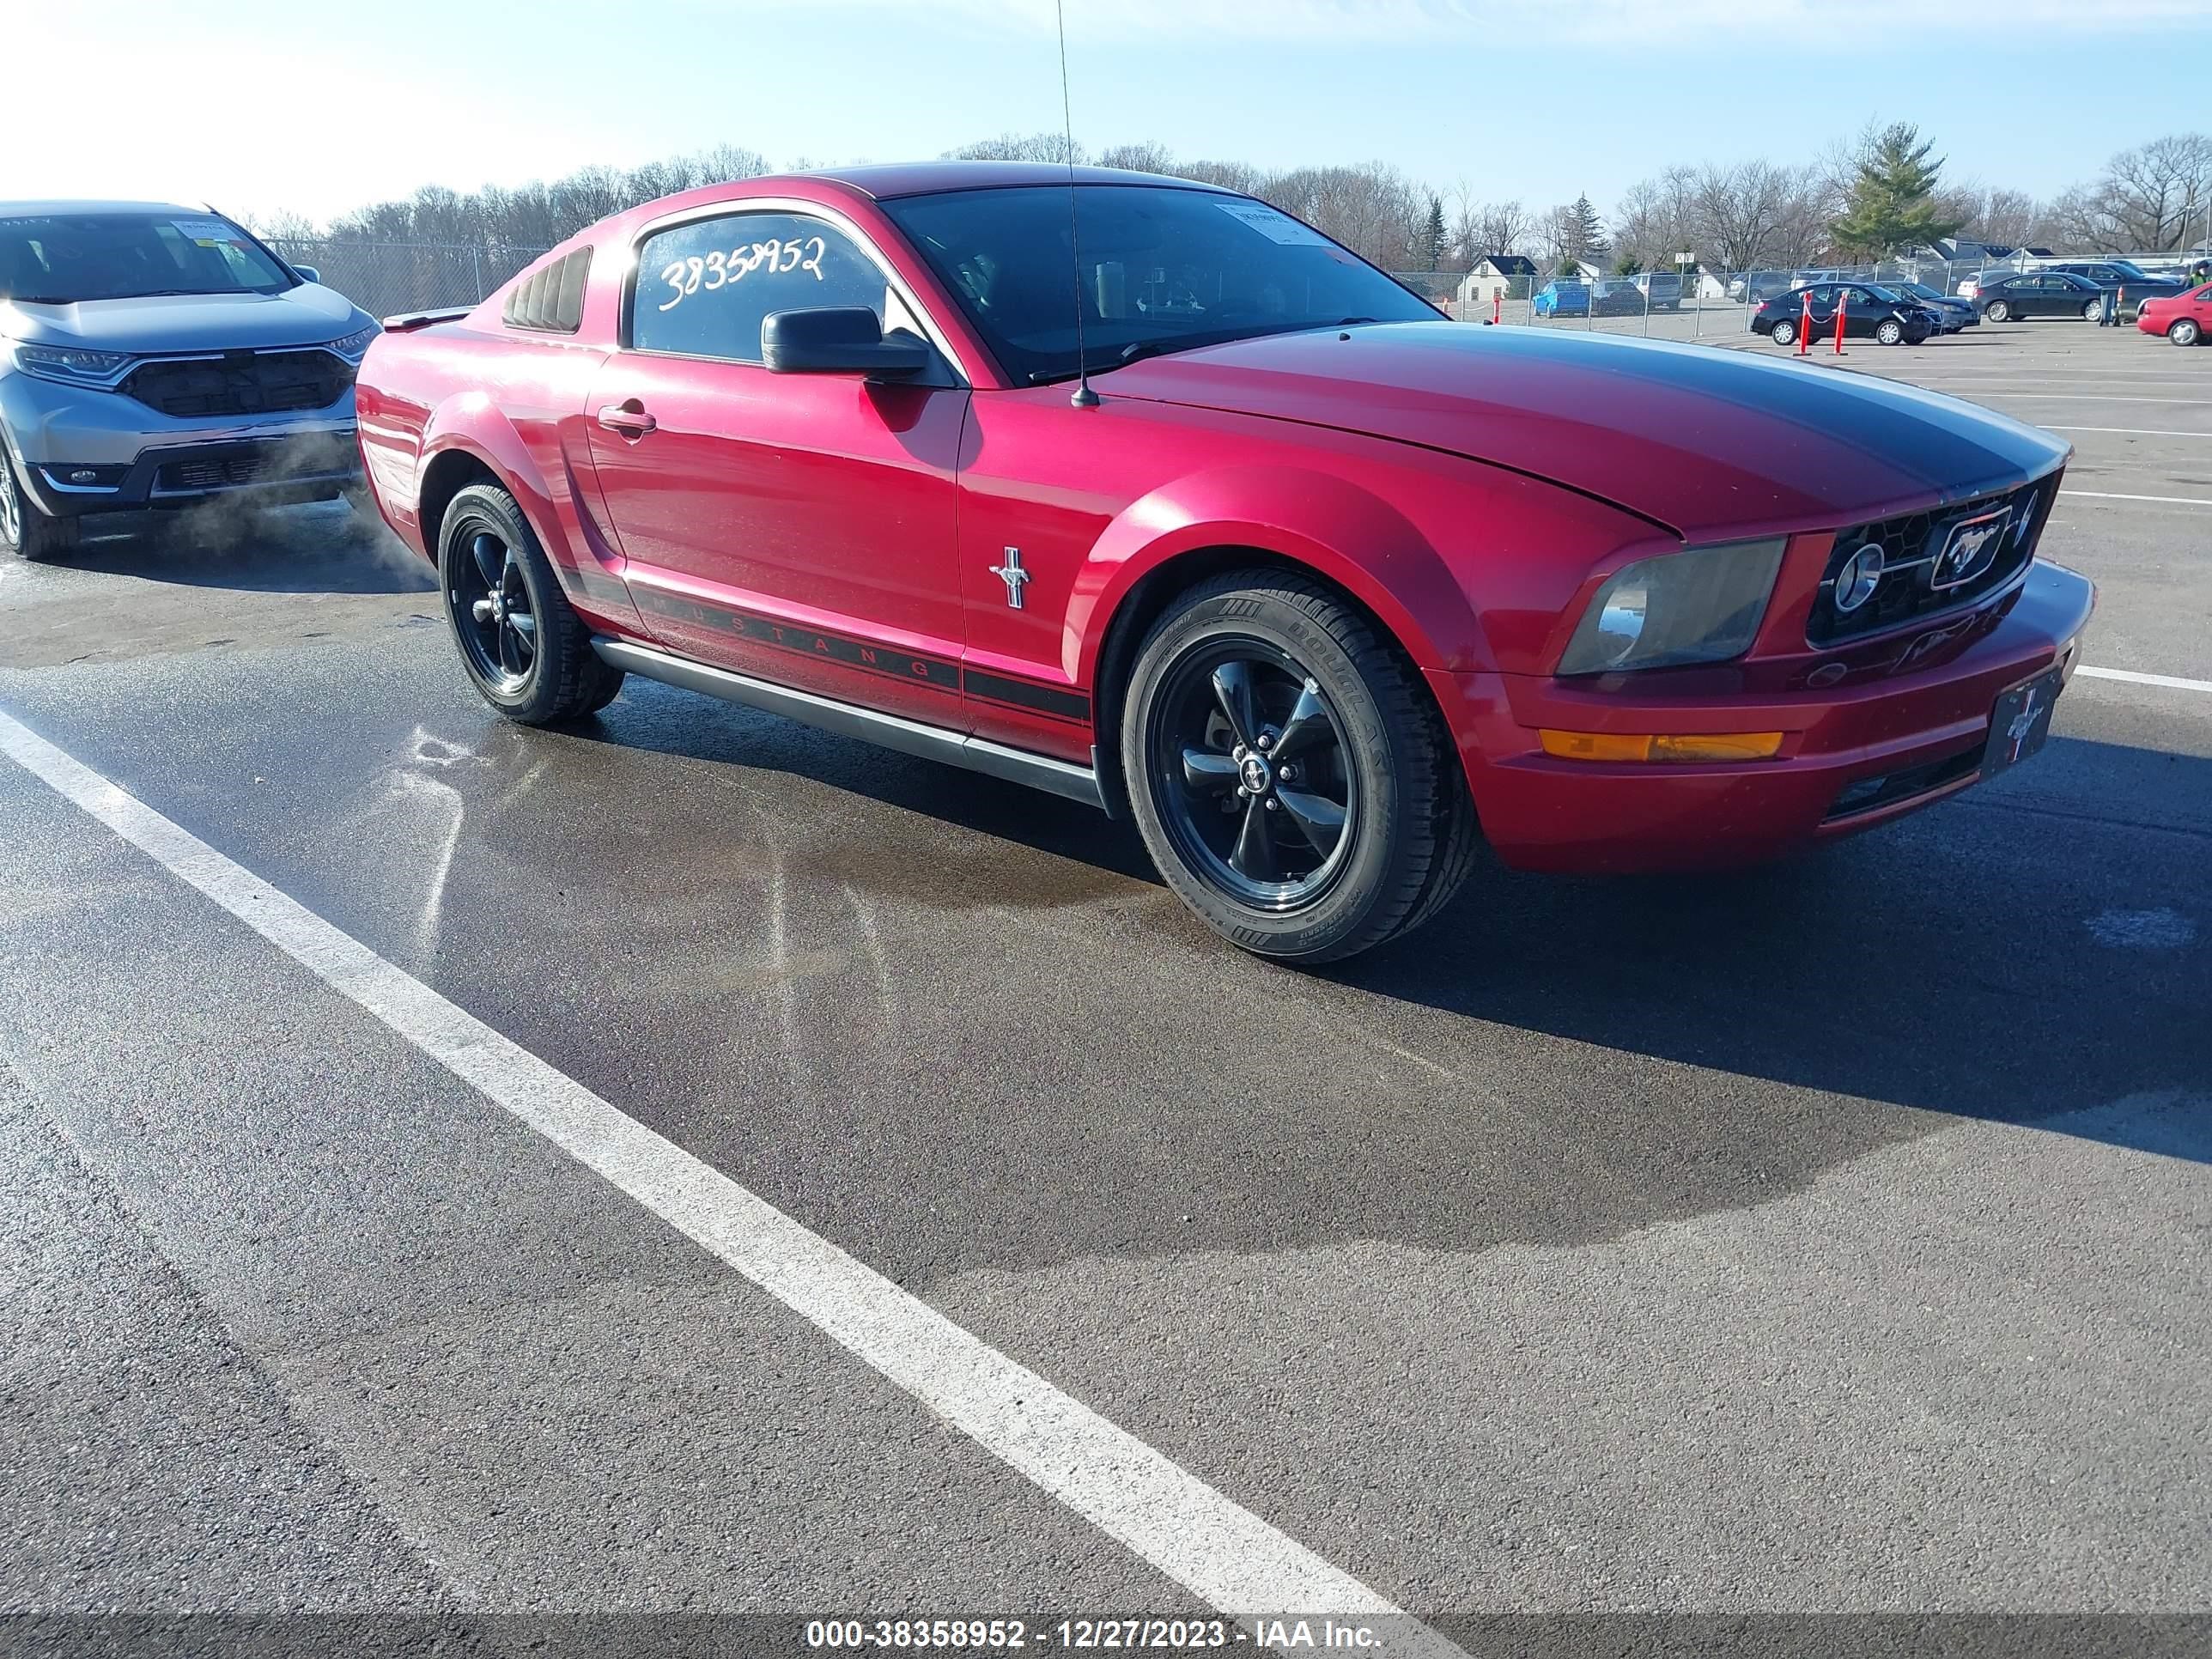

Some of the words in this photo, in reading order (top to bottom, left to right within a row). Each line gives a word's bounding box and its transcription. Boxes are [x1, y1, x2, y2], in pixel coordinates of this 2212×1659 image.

[659, 236, 825, 312] 38358952
[653, 598, 928, 677] MUSTANG
[1289, 621, 1385, 768] DOUGLAS
